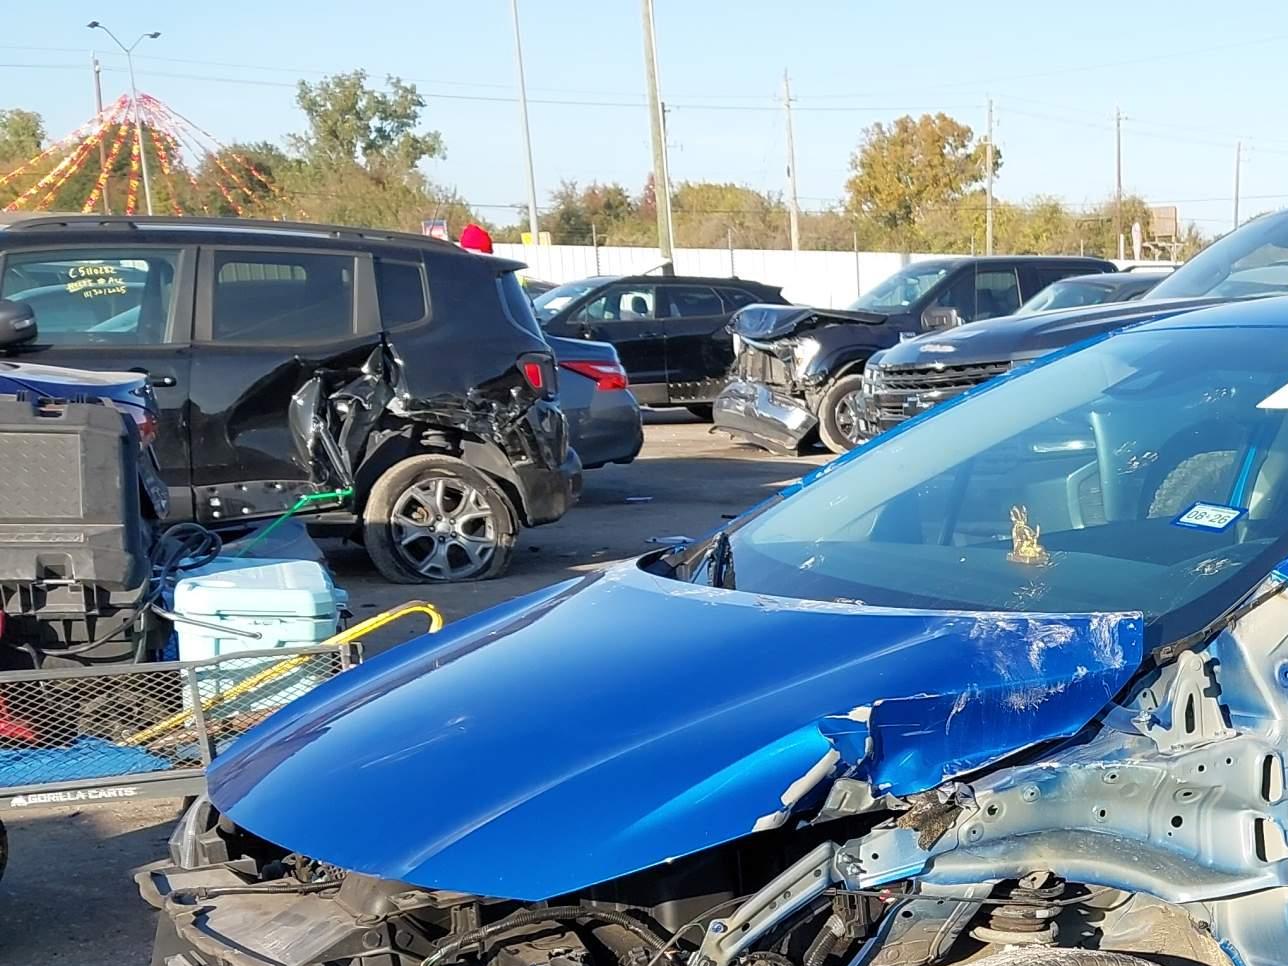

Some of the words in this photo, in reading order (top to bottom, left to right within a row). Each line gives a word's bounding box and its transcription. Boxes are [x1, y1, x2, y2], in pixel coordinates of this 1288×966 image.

[1187, 511, 1207, 520] 08
[1210, 514, 1230, 524] 26
[28, 790, 87, 804] GORILLA
[88, 788, 137, 799] CARTS
